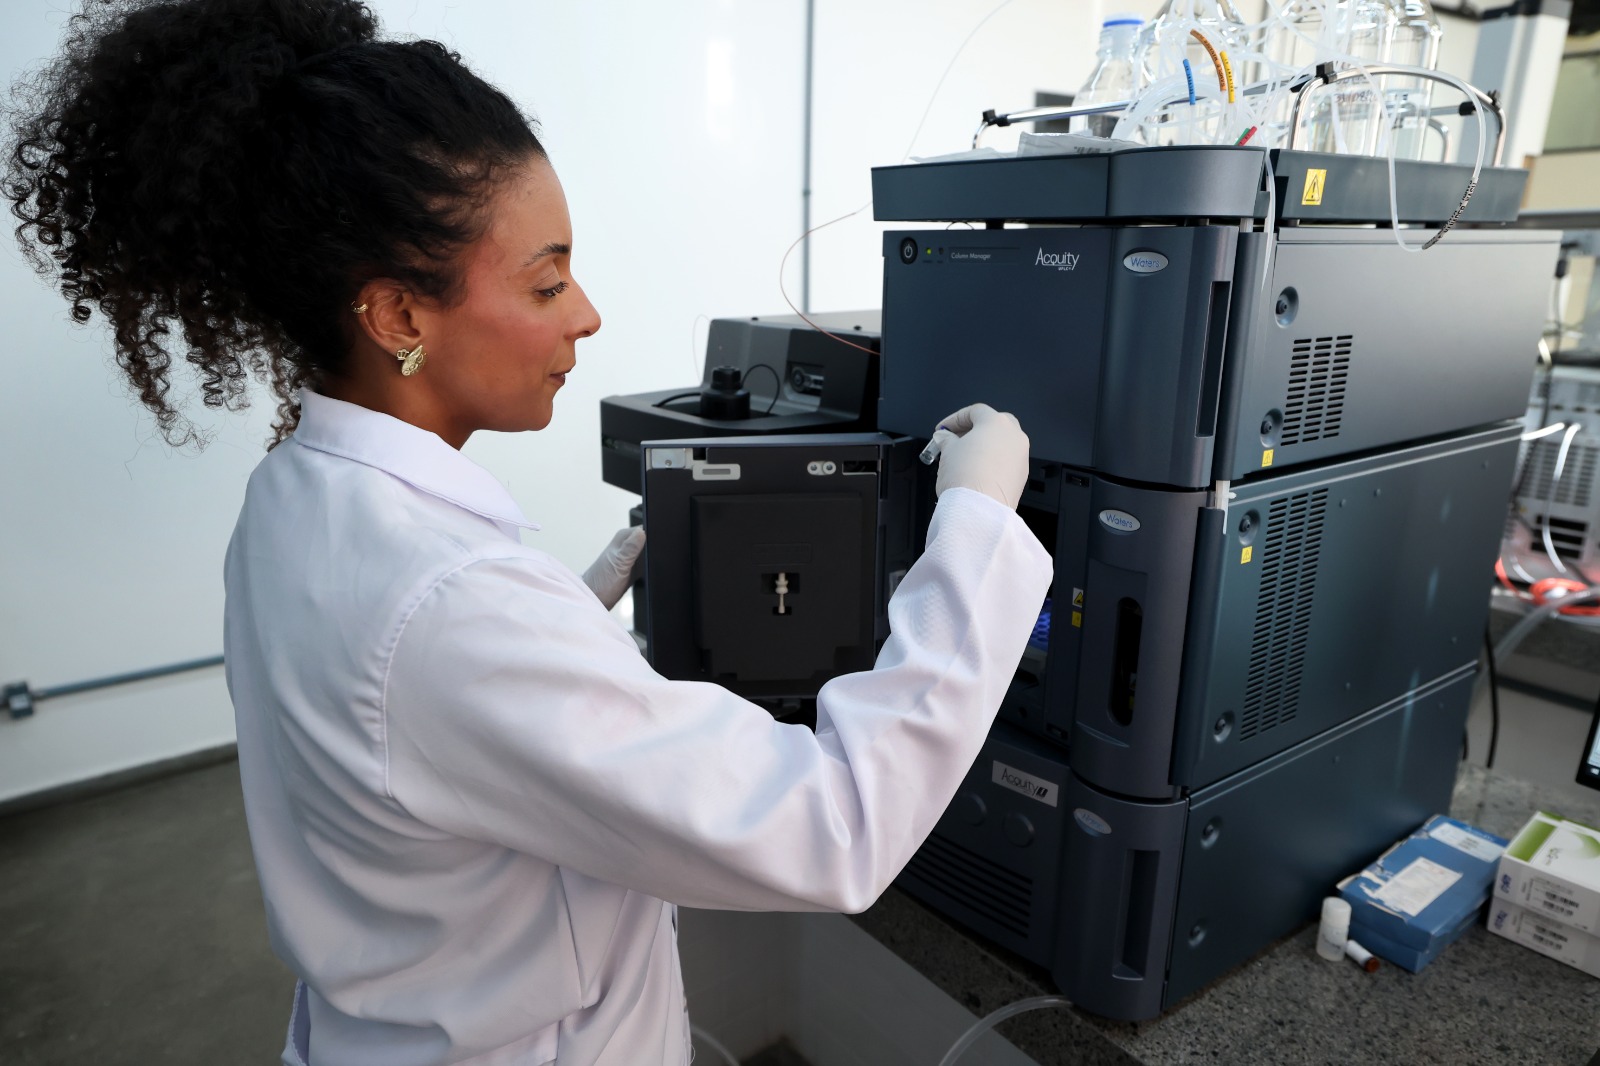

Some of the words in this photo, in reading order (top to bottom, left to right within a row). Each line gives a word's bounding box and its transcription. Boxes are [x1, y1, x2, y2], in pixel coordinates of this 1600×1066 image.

[969, 252, 992, 261] Manager
[1035, 247, 1080, 271] Acquity
[1130, 256, 1161, 268] Waters
[1105, 512, 1133, 529] Waters
[1001, 768, 1039, 796] Acquity
